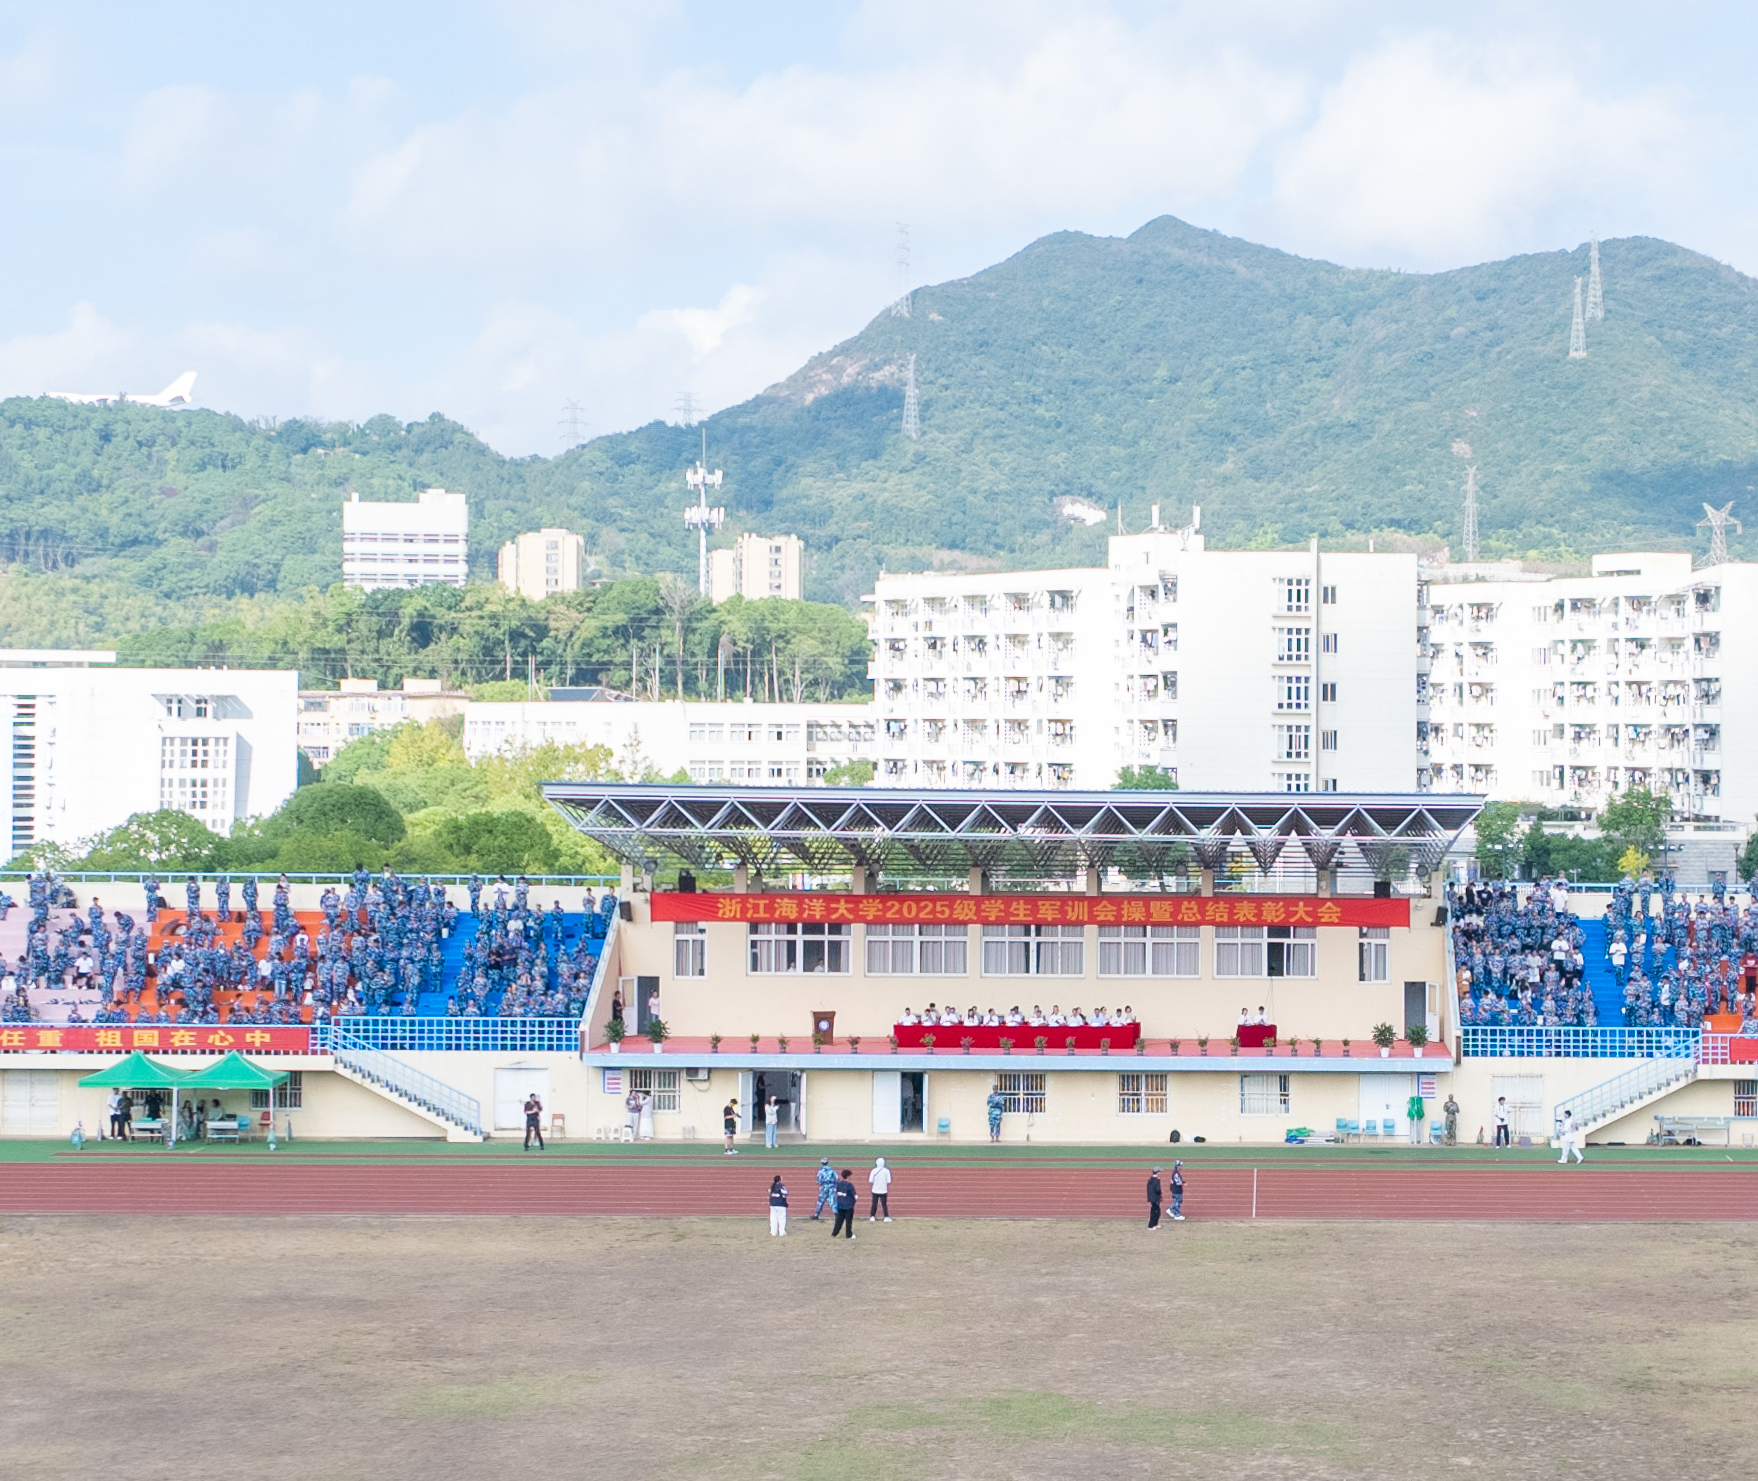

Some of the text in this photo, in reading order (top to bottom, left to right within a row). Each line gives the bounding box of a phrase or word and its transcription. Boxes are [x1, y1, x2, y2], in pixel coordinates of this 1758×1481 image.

[717, 897, 1342, 923] 浙江海洋大学2025级学生军训会操暨总结表彰大会
[95, 1029, 273, 1048] 祖国在心中
